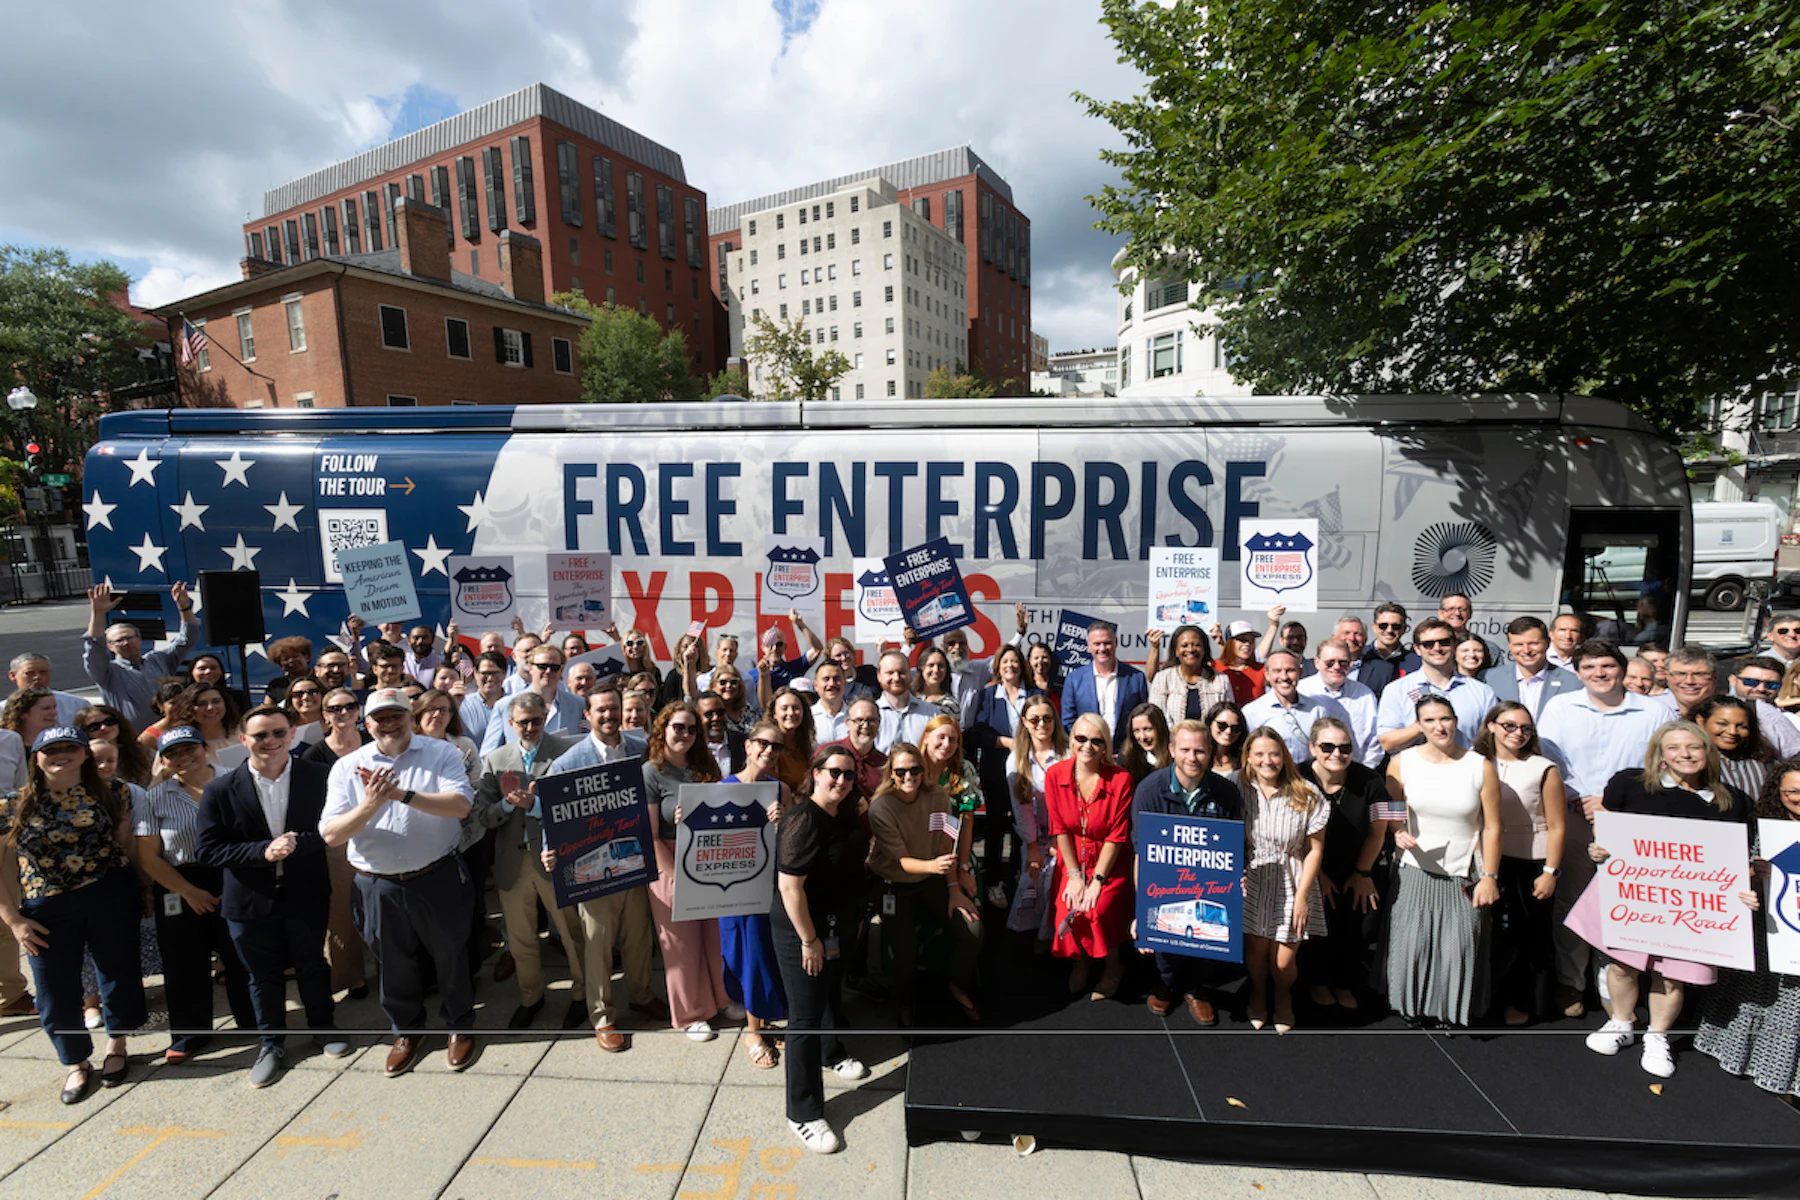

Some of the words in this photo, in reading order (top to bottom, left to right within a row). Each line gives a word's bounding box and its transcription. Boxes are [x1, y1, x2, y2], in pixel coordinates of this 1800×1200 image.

[320, 455, 378, 473] FOLLOW
[319, 477, 349, 496] THE
[349, 477, 386, 496] TOUR
[563, 462, 742, 556] FREE
[772, 461, 1266, 560] ENTERPRISE
[344, 557, 383, 573] KEEPING
[384, 555, 402, 568] THE
[568, 557, 589, 568] FREE
[906, 548, 931, 568] FREE
[1173, 553, 1195, 564] FREE
[1255, 554, 1274, 563] FREE
[553, 570, 605, 581] ENTERPRISE
[774, 565, 790, 573] FREE
[895, 557, 952, 588] ENTERPRISE
[1156, 566, 1211, 579] ENTERPRISE
[1255, 563, 1302, 573] ENTERPRISE
[349, 569, 402, 590] American
[773, 573, 811, 583] ENTERPRISE
[364, 582, 400, 598] Dream
[463, 584, 481, 593] FREE
[464, 593, 504, 601] ENTERPRISE
[866, 589, 883, 598] FREE
[360, 601, 371, 612] IN
[372, 595, 408, 611] MOTION
[570, 571, 1002, 662] XPES
[43, 726, 78, 741] 20062
[161, 726, 193, 744] 20062
[575, 772, 611, 796] FREE
[551, 787, 639, 823] ENTERPRISE
[585, 816, 605, 831] The
[559, 826, 615, 857] Opportunity
[614, 813, 641, 833] Tour!
[697, 834, 722, 848] FREE
[1173, 824, 1208, 846] FREE
[696, 846, 756, 862] ENTERPRISE
[1147, 844, 1234, 871] ENTERPRISE
[1633, 838, 1704, 863] WHERE
[696, 860, 756, 872] EXPRESS
[1176, 868, 1196, 881] The
[1607, 858, 1738, 891] Opportunity
[1146, 883, 1204, 899] Opportunity
[1205, 881, 1234, 895] Tour!
[1618, 881, 1683, 907] MEETS
[1688, 890, 1727, 913] THE
[1610, 904, 1666, 926] Open
[1668, 910, 1739, 934] Road
